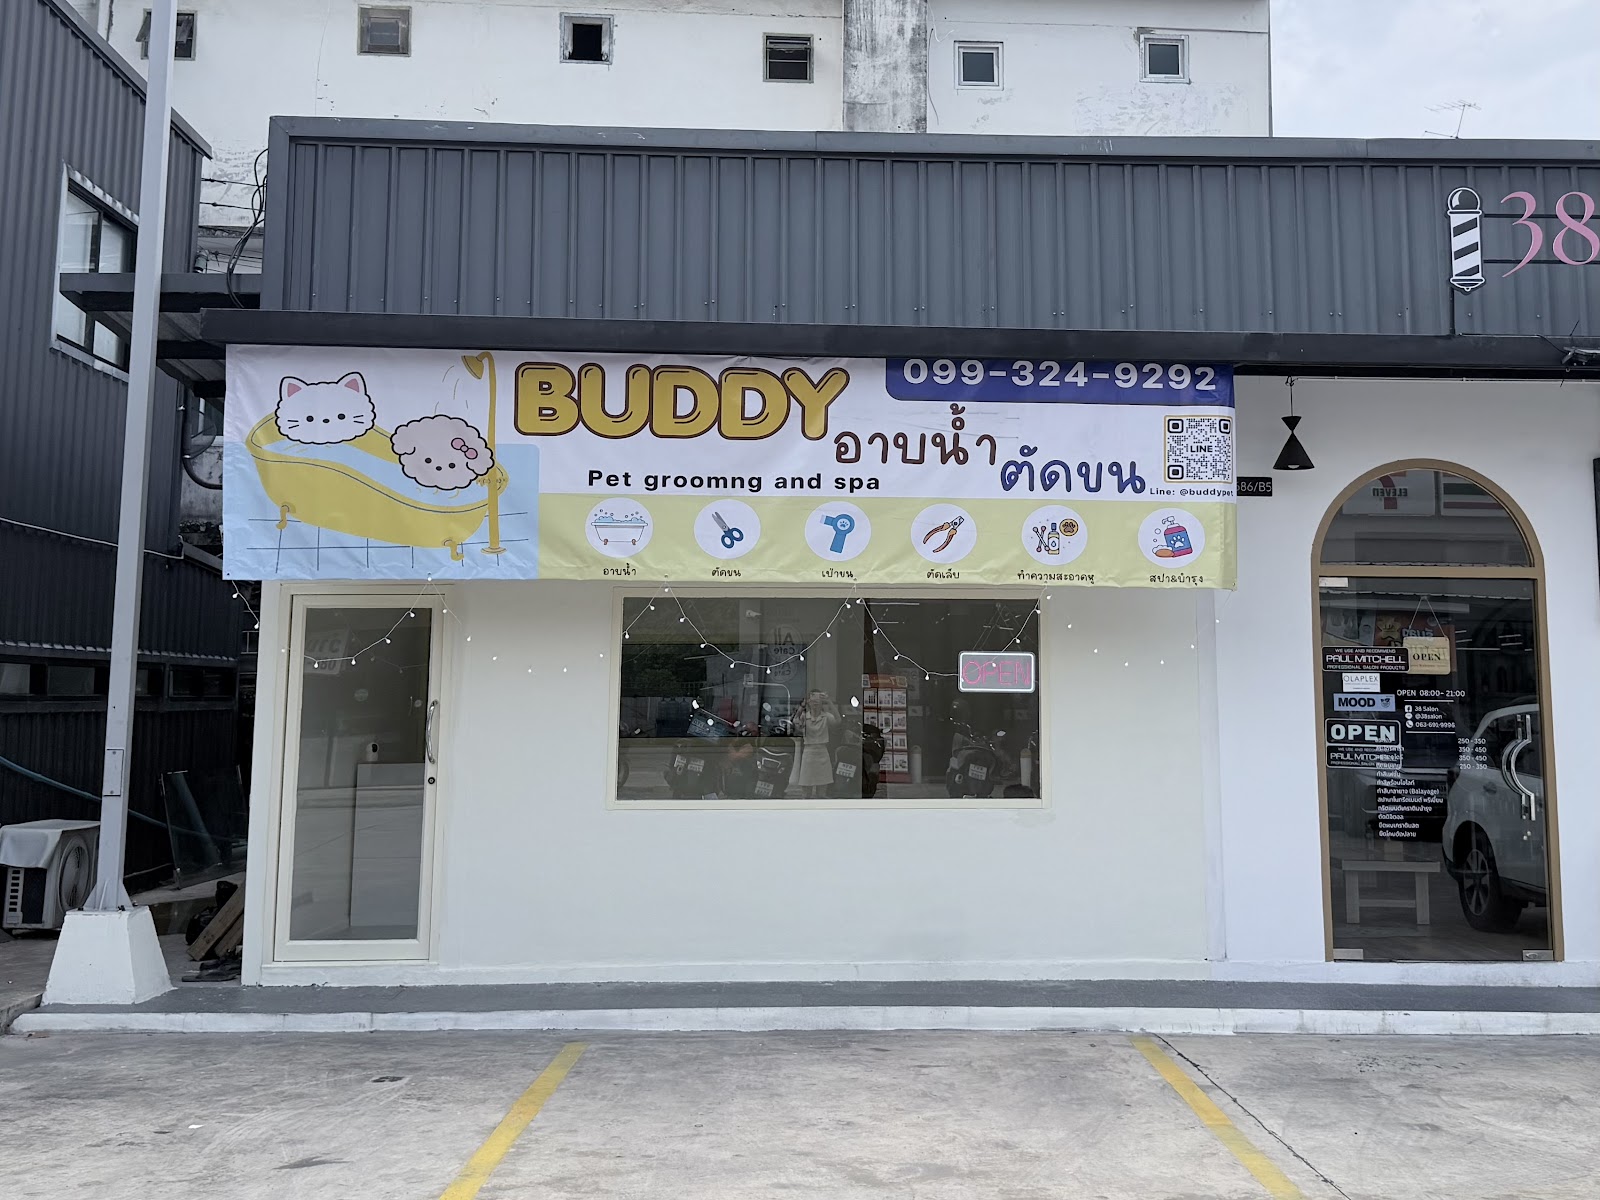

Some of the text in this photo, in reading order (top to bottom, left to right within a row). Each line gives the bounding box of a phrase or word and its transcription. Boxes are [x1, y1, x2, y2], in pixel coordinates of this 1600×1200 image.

[1500, 191, 1600, 278] 38
[903, 359, 1216, 390] 099-324-9292
[514, 362, 850, 440] BUDDY
[834, 403, 997, 466] อาบน้ำ
[1190, 445, 1213, 453] LINE
[1000, 444, 1147, 494] ตัดขน
[588, 469, 880, 493] Pet groomng and spa
[1150, 488, 1234, 498] Line: @buddypet
[603, 563, 637, 577] อาบน้ำ
[711, 567, 742, 577] ตัดขน
[821, 568, 854, 579] เป่าขน
[926, 569, 960, 580] ตัดเล็บ
[1017, 571, 1096, 585] ทำความสะอาดหู
[1149, 572, 1204, 585] สปา&บำรุง
[1326, 655, 1406, 664] PAUL MITCHELL
[1413, 653, 1441, 661] OPEN
[962, 661, 1031, 686] OPEN
[1343, 675, 1379, 683] OLAPLEX
[1396, 689, 1417, 697] OPEN
[1446, 690, 1466, 698] 21:00
[1338, 697, 1376, 708] MOOD
[1330, 723, 1396, 742] OPEN
[1330, 752, 1354, 761] PAUL
